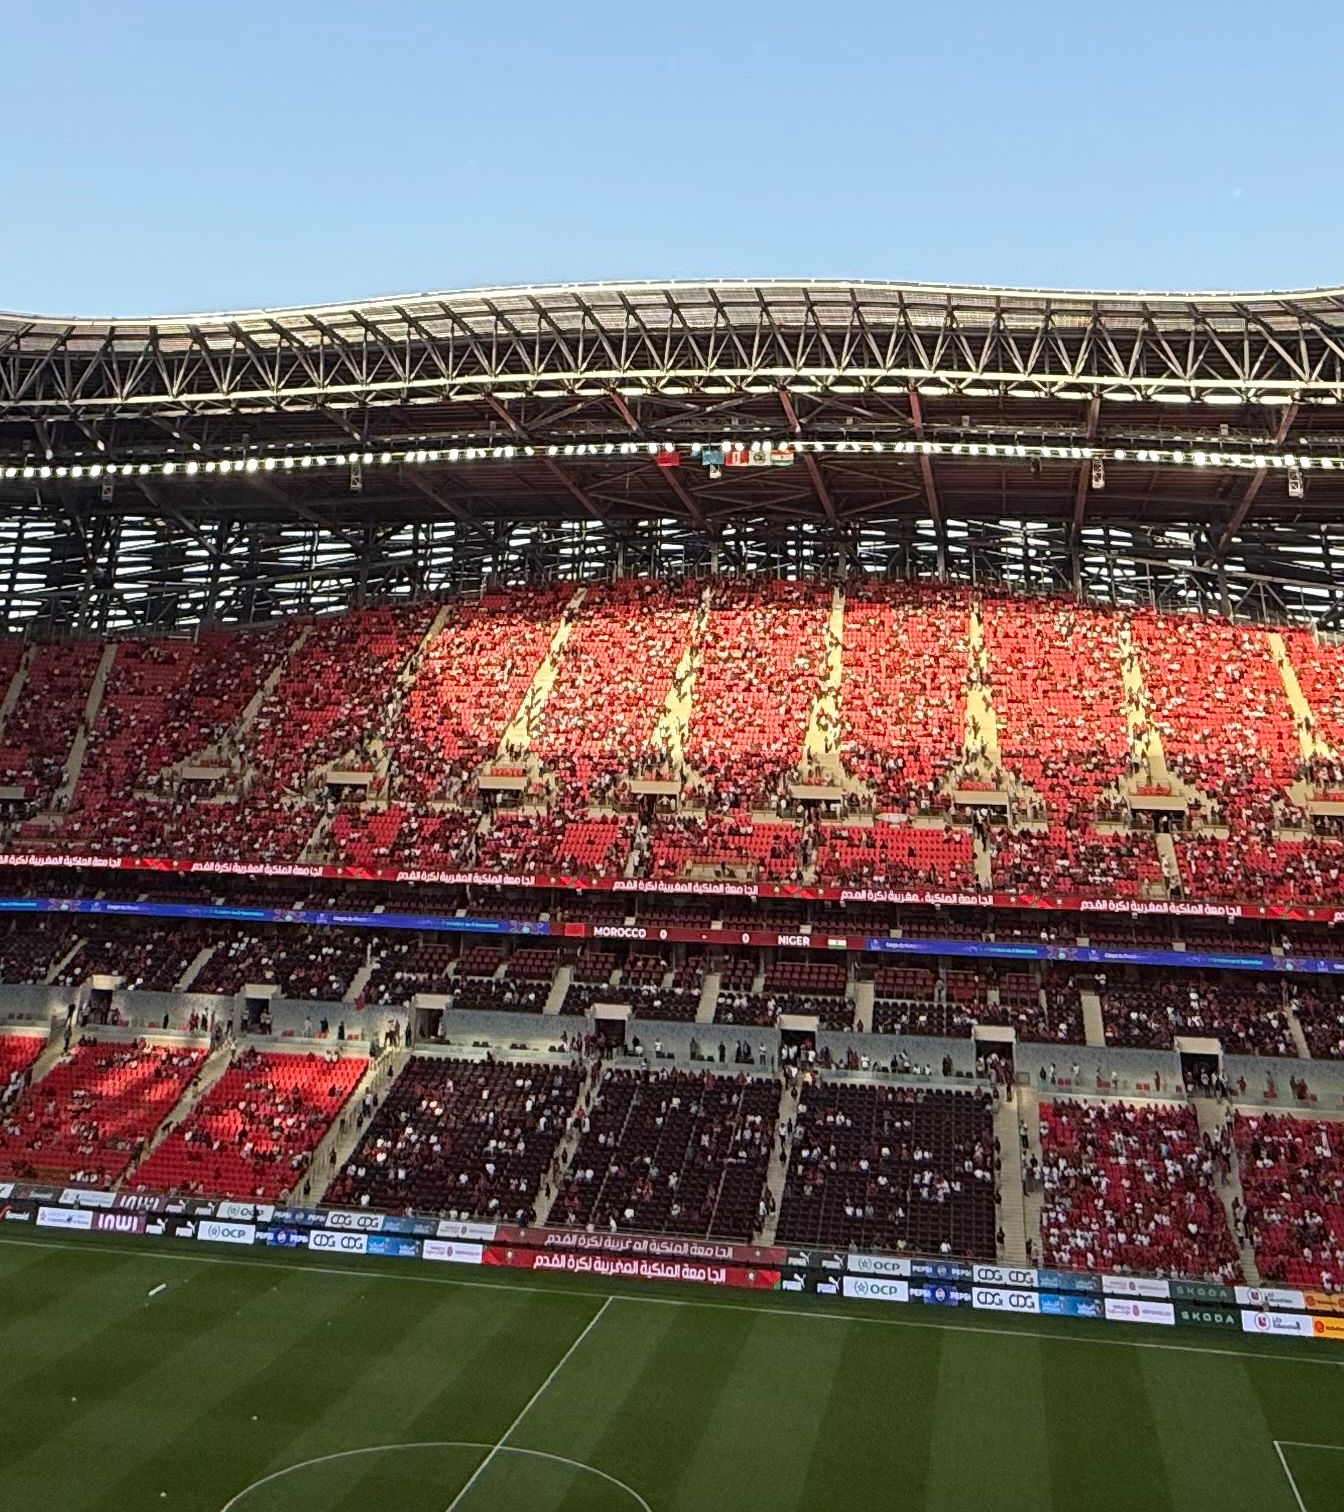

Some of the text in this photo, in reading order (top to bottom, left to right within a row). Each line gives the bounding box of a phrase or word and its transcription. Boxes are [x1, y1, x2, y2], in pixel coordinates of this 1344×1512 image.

[594, 926, 810, 946] MOROCCO 0 0 NIGER
[331, 1214, 379, 1228] CDG CDG
[221, 1229, 245, 1239] OCP
[313, 1234, 336, 1247] CDG
[341, 1236, 363, 1249] CDG
[874, 1261, 900, 1271] OCP
[977, 1268, 1034, 1284] CDG CDG
[870, 1284, 898, 1295] OCP
[977, 1291, 1003, 1306] CDG
[1009, 1293, 1035, 1309] CDG
